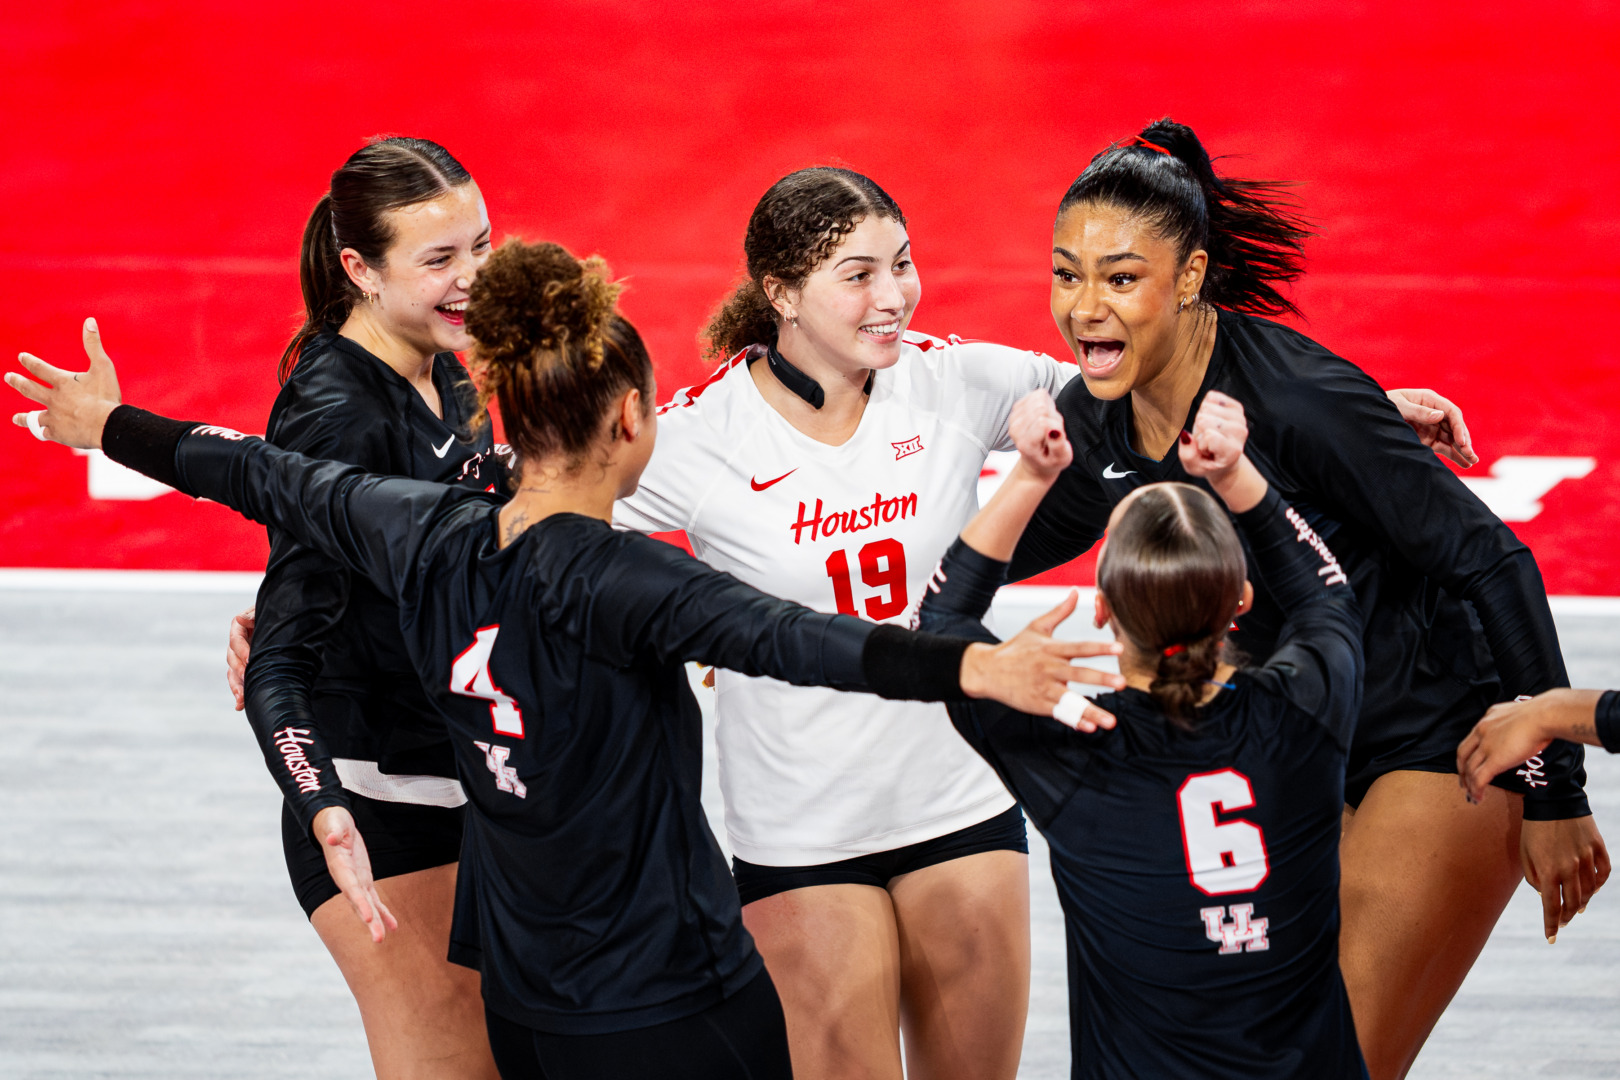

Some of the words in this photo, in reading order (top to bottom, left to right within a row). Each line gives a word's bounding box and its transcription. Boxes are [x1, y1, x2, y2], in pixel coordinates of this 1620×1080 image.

[790, 492, 918, 545] Houston
[1285, 506, 1348, 587] Houston
[825, 537, 909, 621] 19
[449, 623, 526, 740] 4
[273, 726, 323, 795] Houston
[1176, 766, 1271, 897] 6
[1200, 902, 1270, 955] UH
